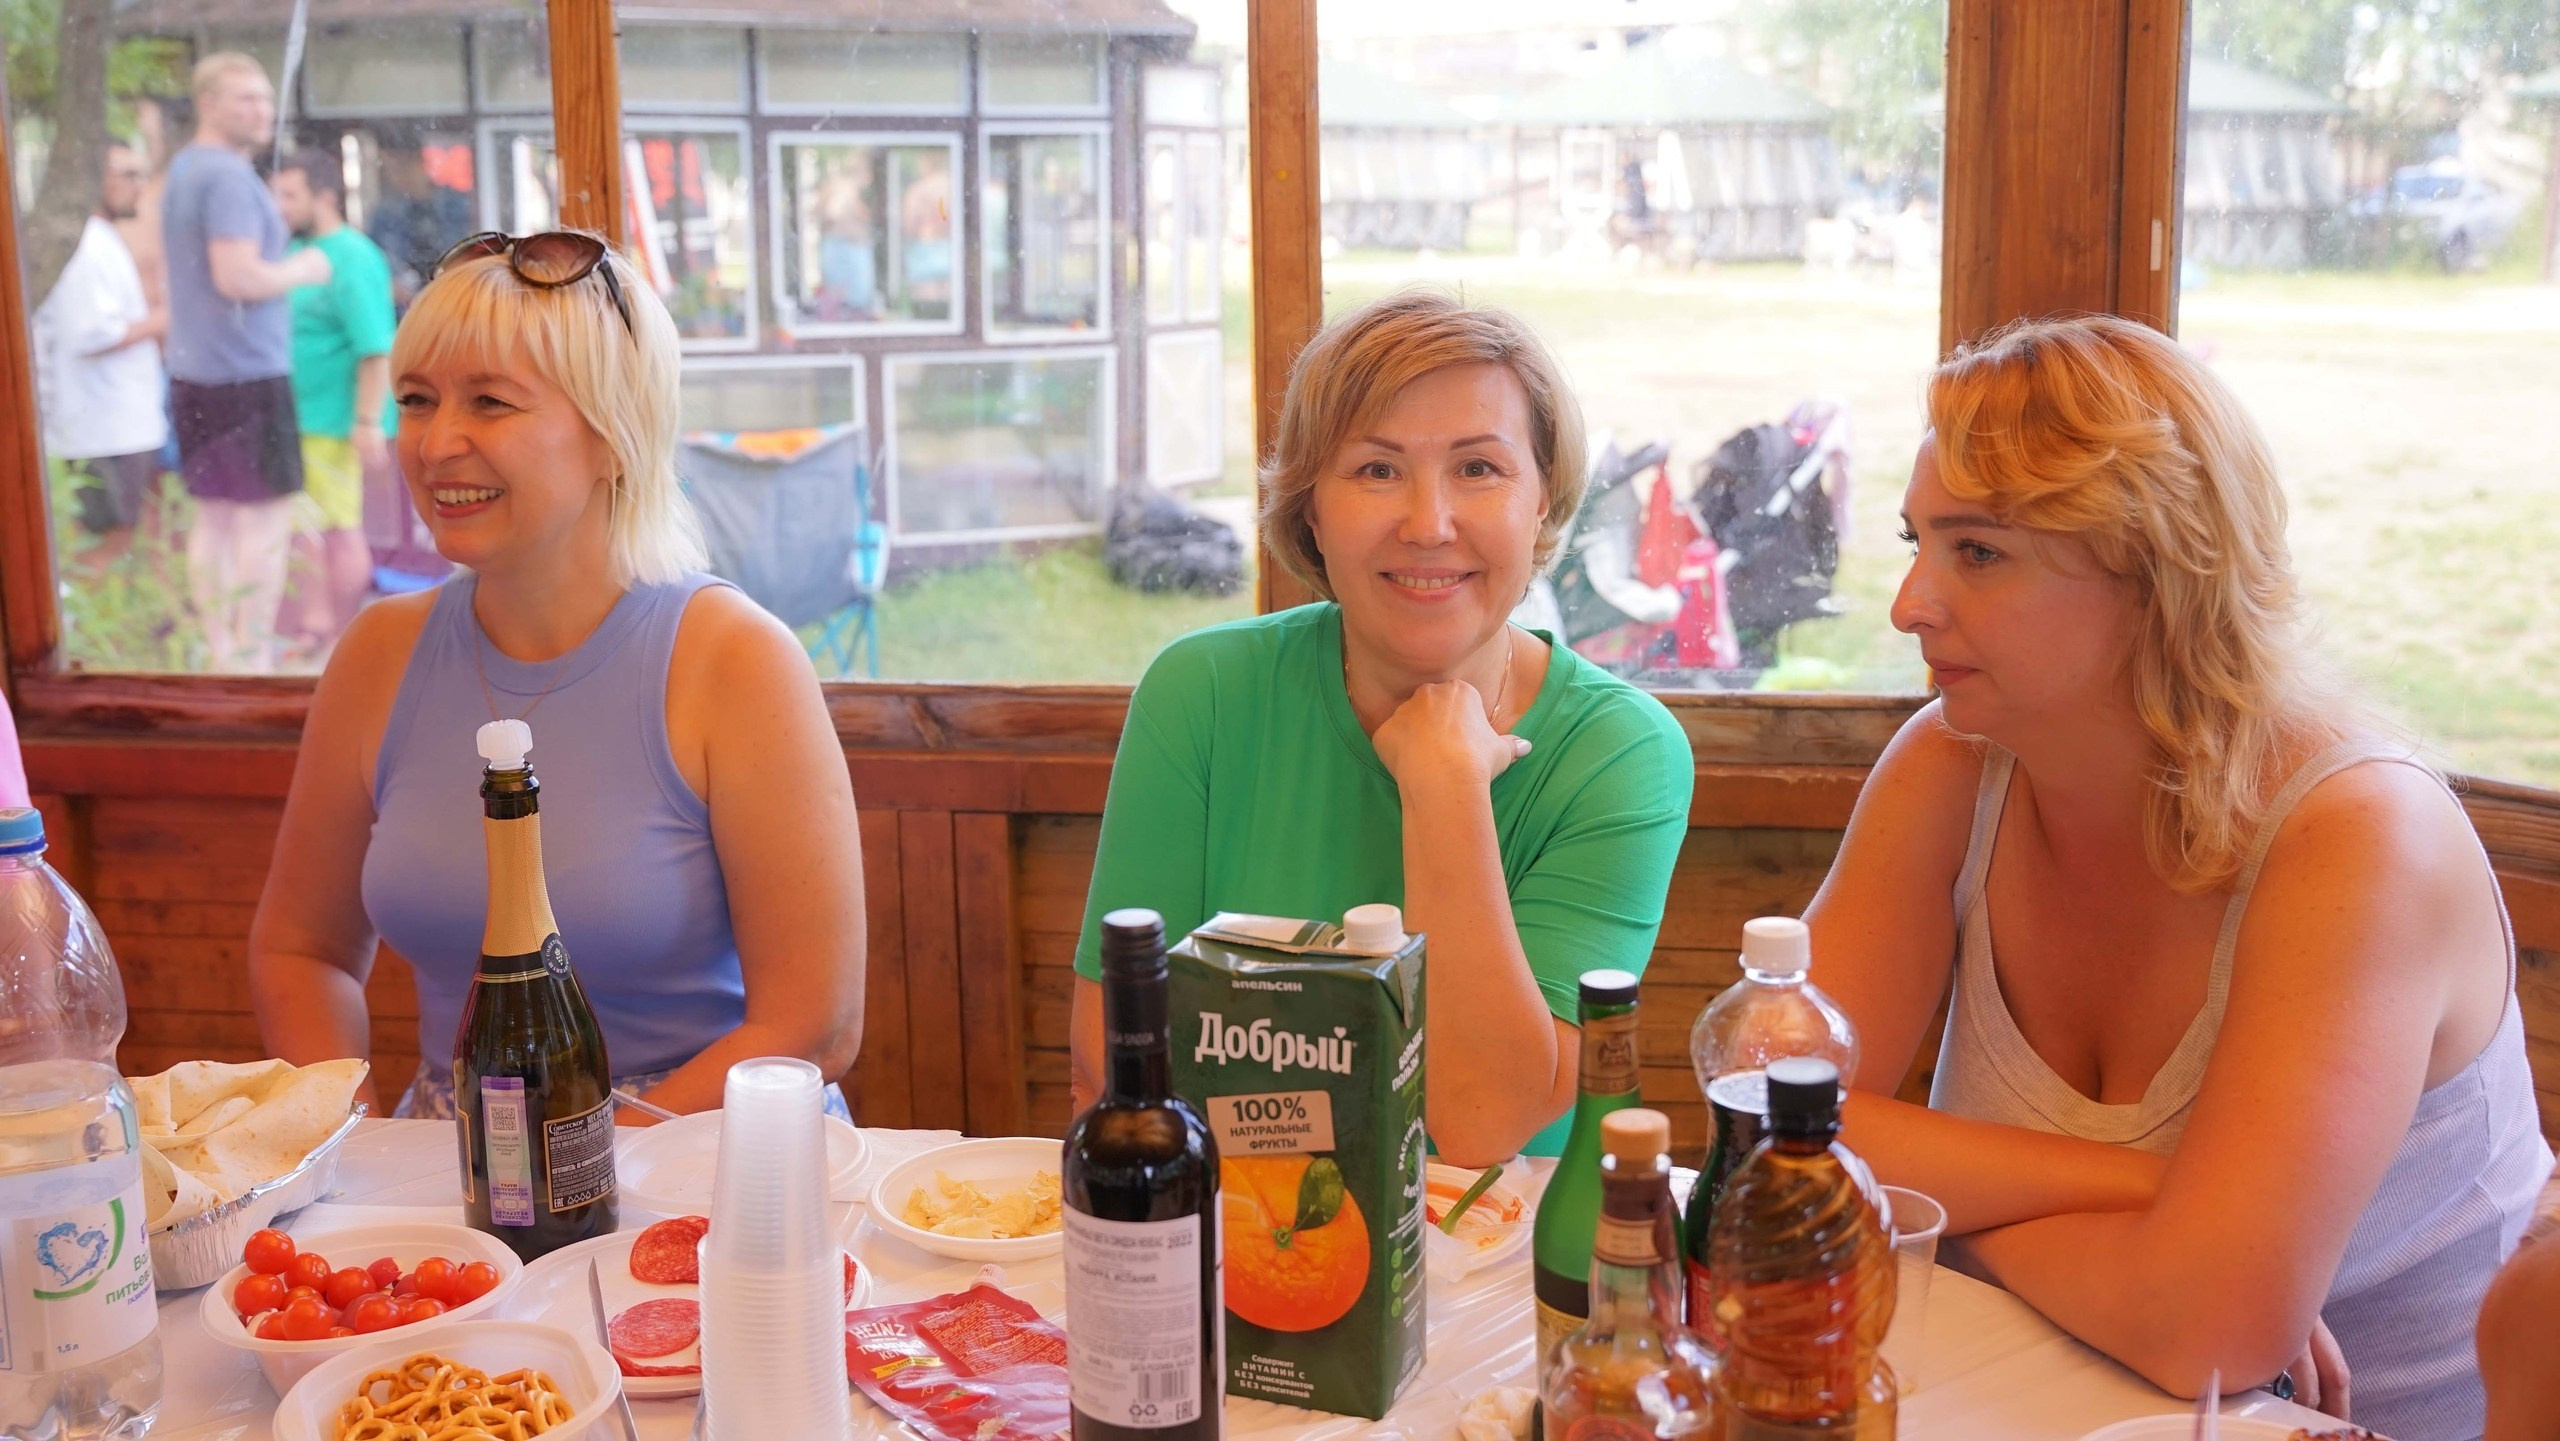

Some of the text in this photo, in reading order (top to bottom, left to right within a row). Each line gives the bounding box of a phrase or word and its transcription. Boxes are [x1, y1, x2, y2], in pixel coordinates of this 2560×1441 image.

[1232, 980, 1303, 992] апельсин
[1194, 1011, 1353, 1075] Добрый
[1232, 1096, 1307, 1123] 100%
[1230, 1123, 1312, 1137] НАТУРАЛЬНЫЕ
[1249, 1138, 1298, 1150] ФРУКТЫ
[848, 1321, 907, 1340] HEINZ
[1242, 1362, 1295, 1377] ВИТАМИН
[1251, 1354, 1295, 1368] Содержит
[1234, 1369, 1315, 1391] БЕЗ консервантов
[1240, 1379, 1310, 1399] БЕЗ красителей
